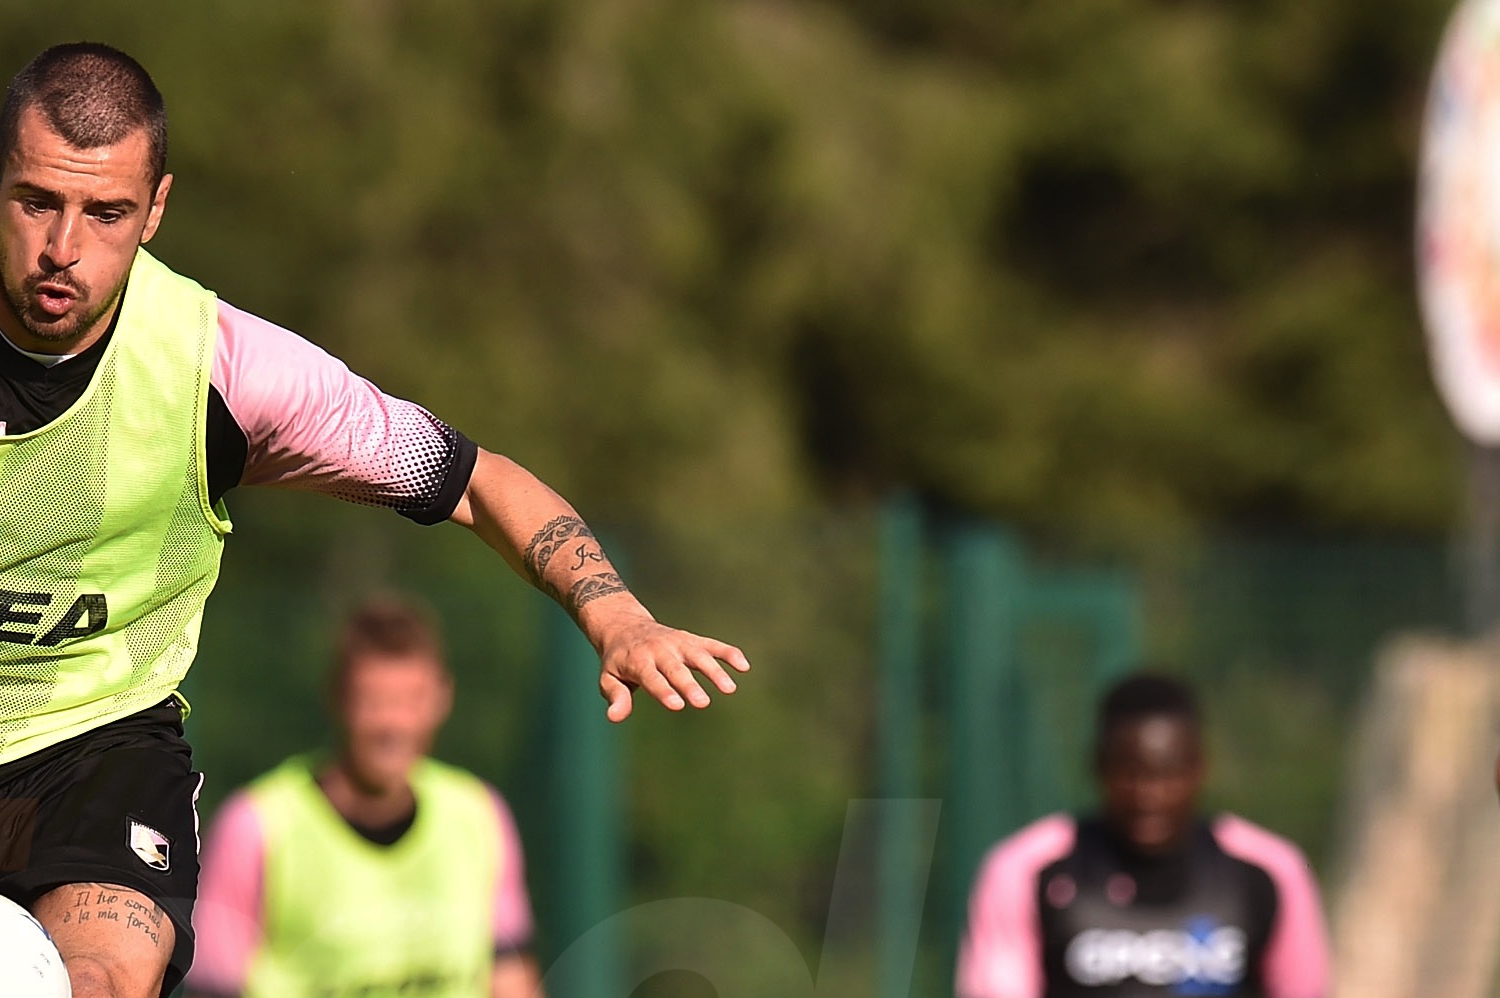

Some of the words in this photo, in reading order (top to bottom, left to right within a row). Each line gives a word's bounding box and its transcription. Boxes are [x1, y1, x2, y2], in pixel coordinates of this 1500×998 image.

[73, 891, 90, 908] Il
[96, 891, 118, 905] tuo
[78, 908, 90, 924] la
[97, 907, 120, 922] mia
